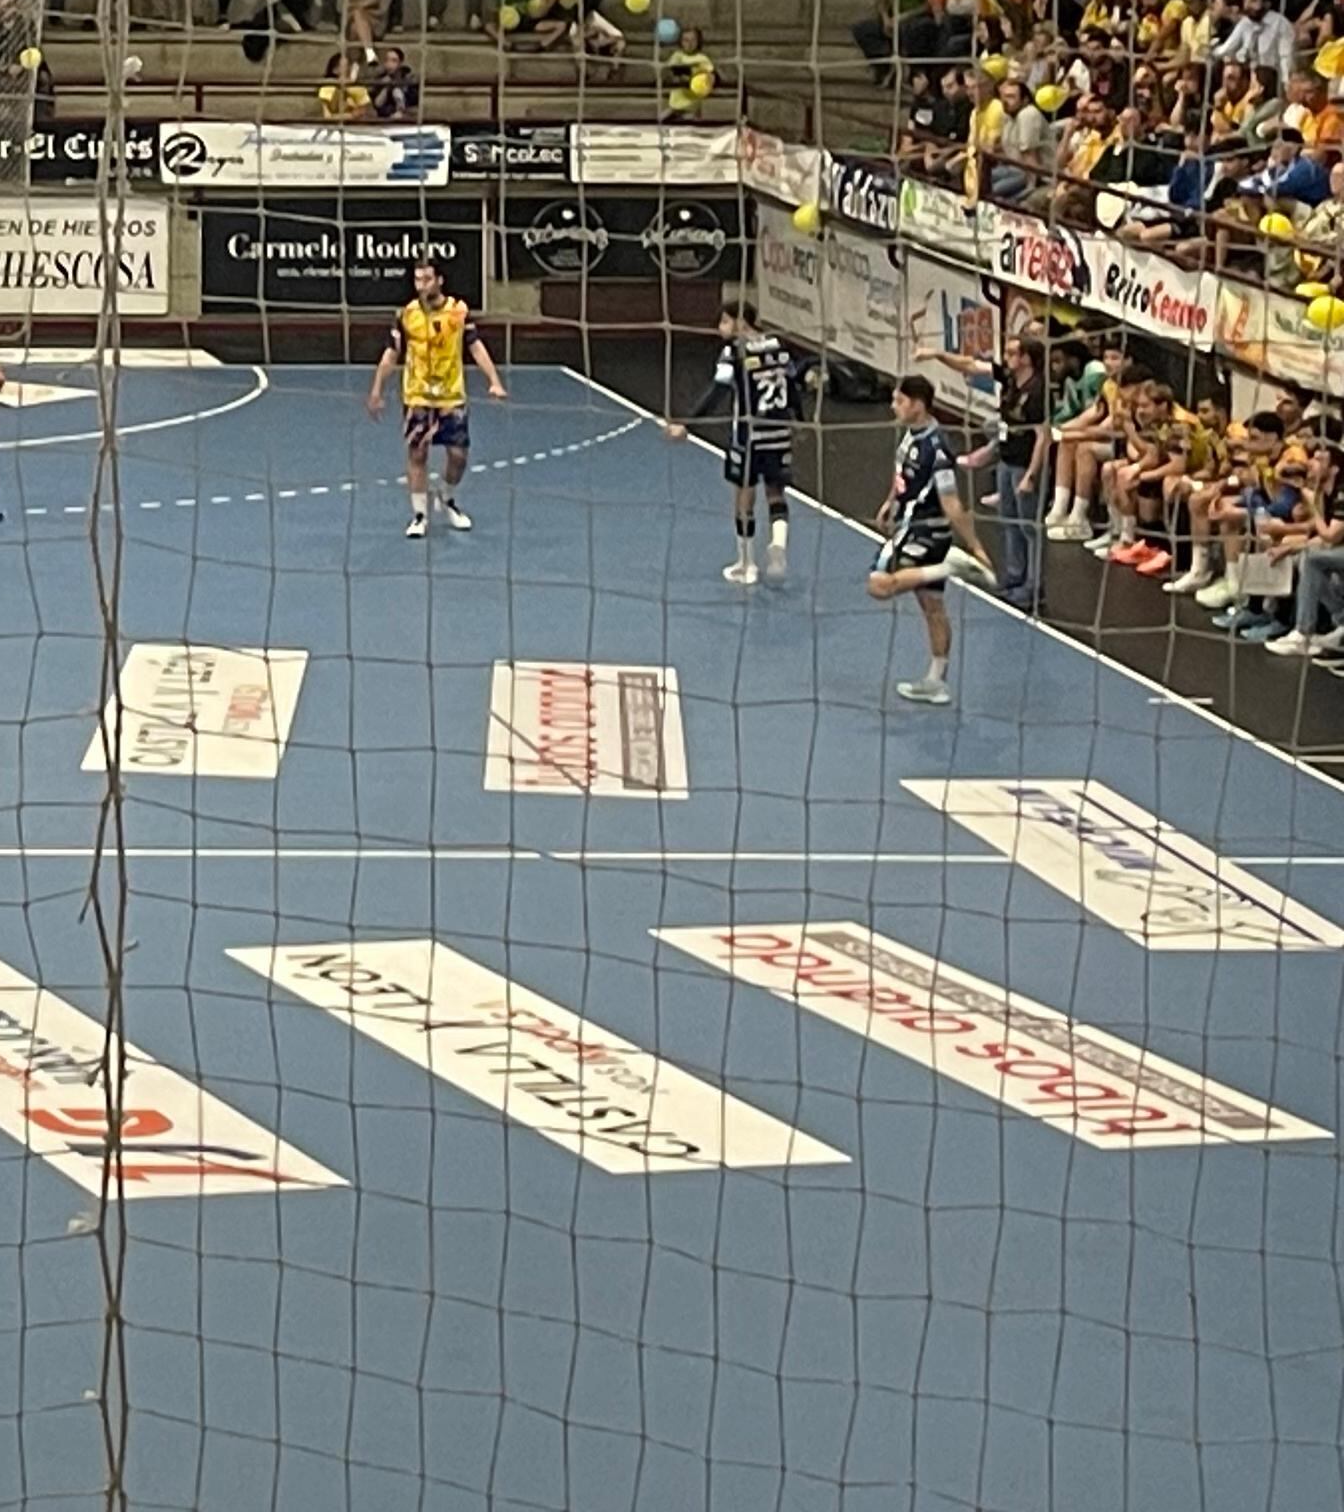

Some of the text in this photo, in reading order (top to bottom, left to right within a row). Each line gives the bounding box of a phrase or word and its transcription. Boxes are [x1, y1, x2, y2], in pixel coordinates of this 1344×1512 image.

[31, 219, 58, 238] DE
[63, 219, 157, 238] HIEOS
[228, 232, 457, 260] Carmelo Rodero
[287, 951, 434, 1010] LEÓN
[456, 1041, 700, 1159] CASTILLA
